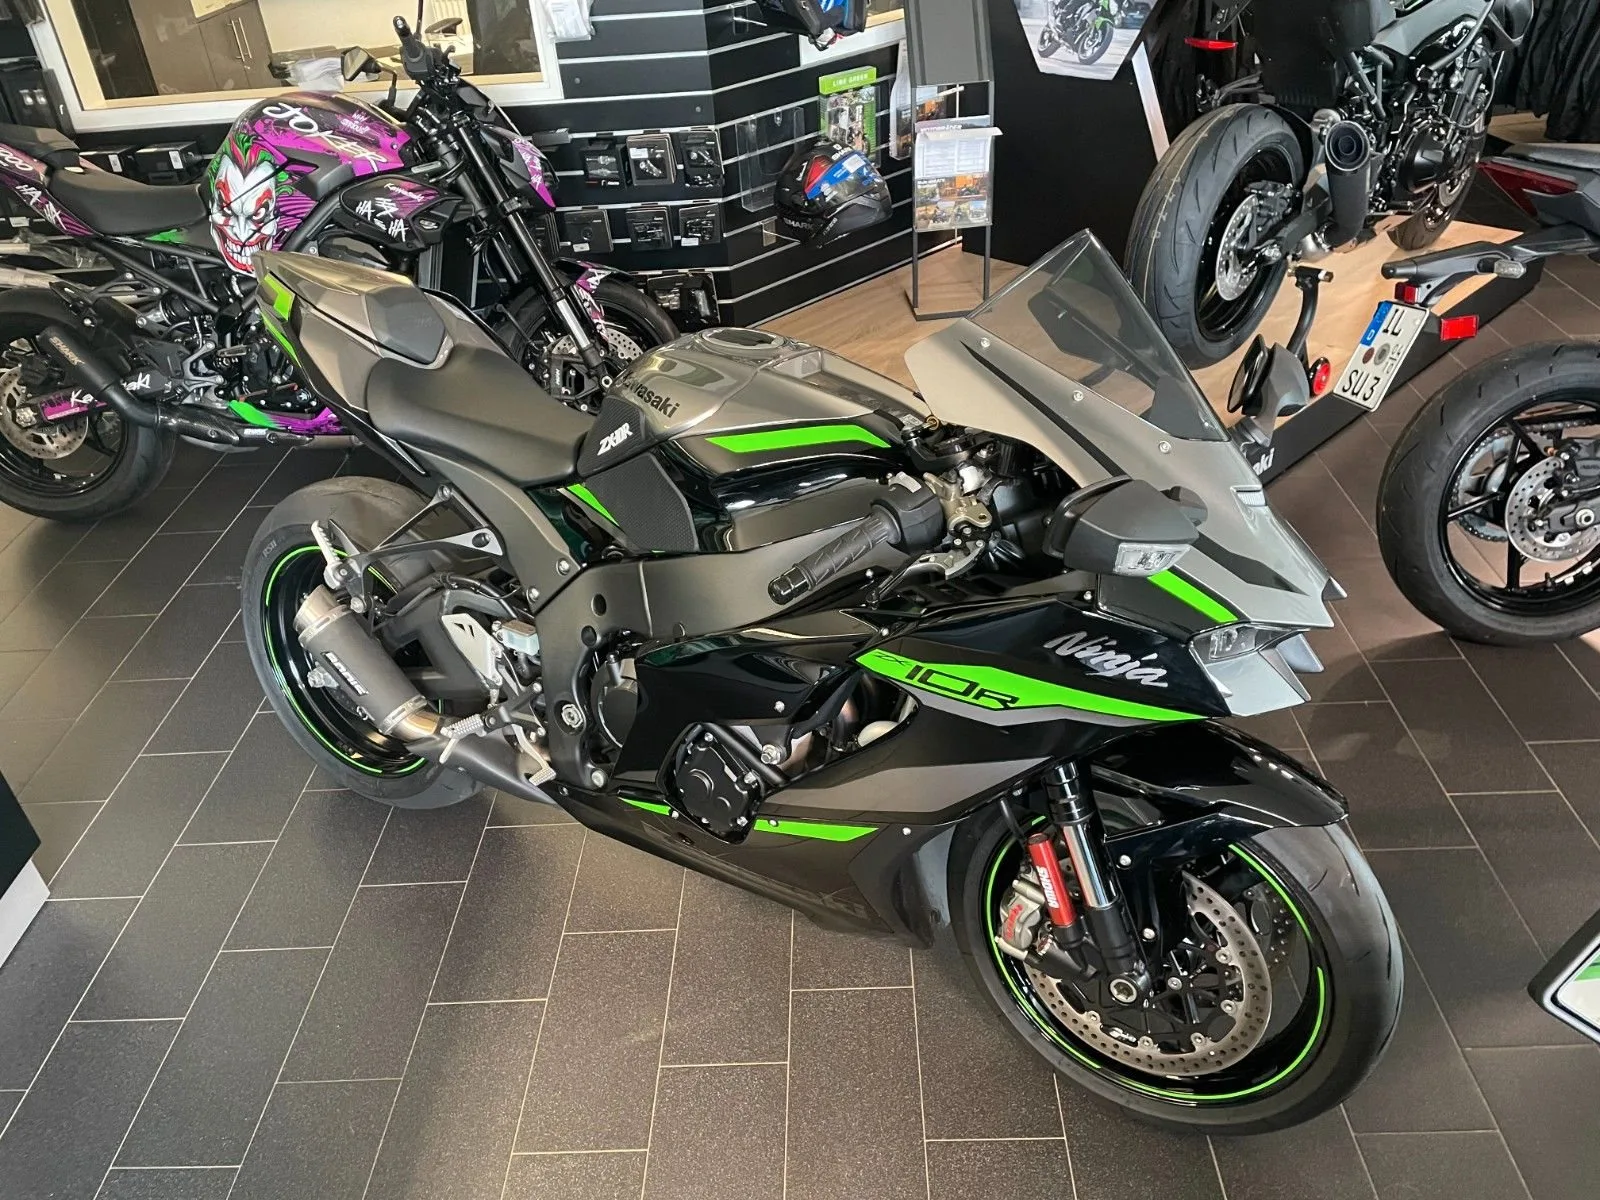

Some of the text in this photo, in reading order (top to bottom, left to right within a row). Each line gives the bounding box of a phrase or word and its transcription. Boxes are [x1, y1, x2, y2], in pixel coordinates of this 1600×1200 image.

[262, 102, 388, 172] JOKER
[355, 200, 376, 221] HA
[387, 218, 409, 243] HA
[1043, 631, 1169, 688] Ninja
[1035, 865, 1060, 909] SHOWA
